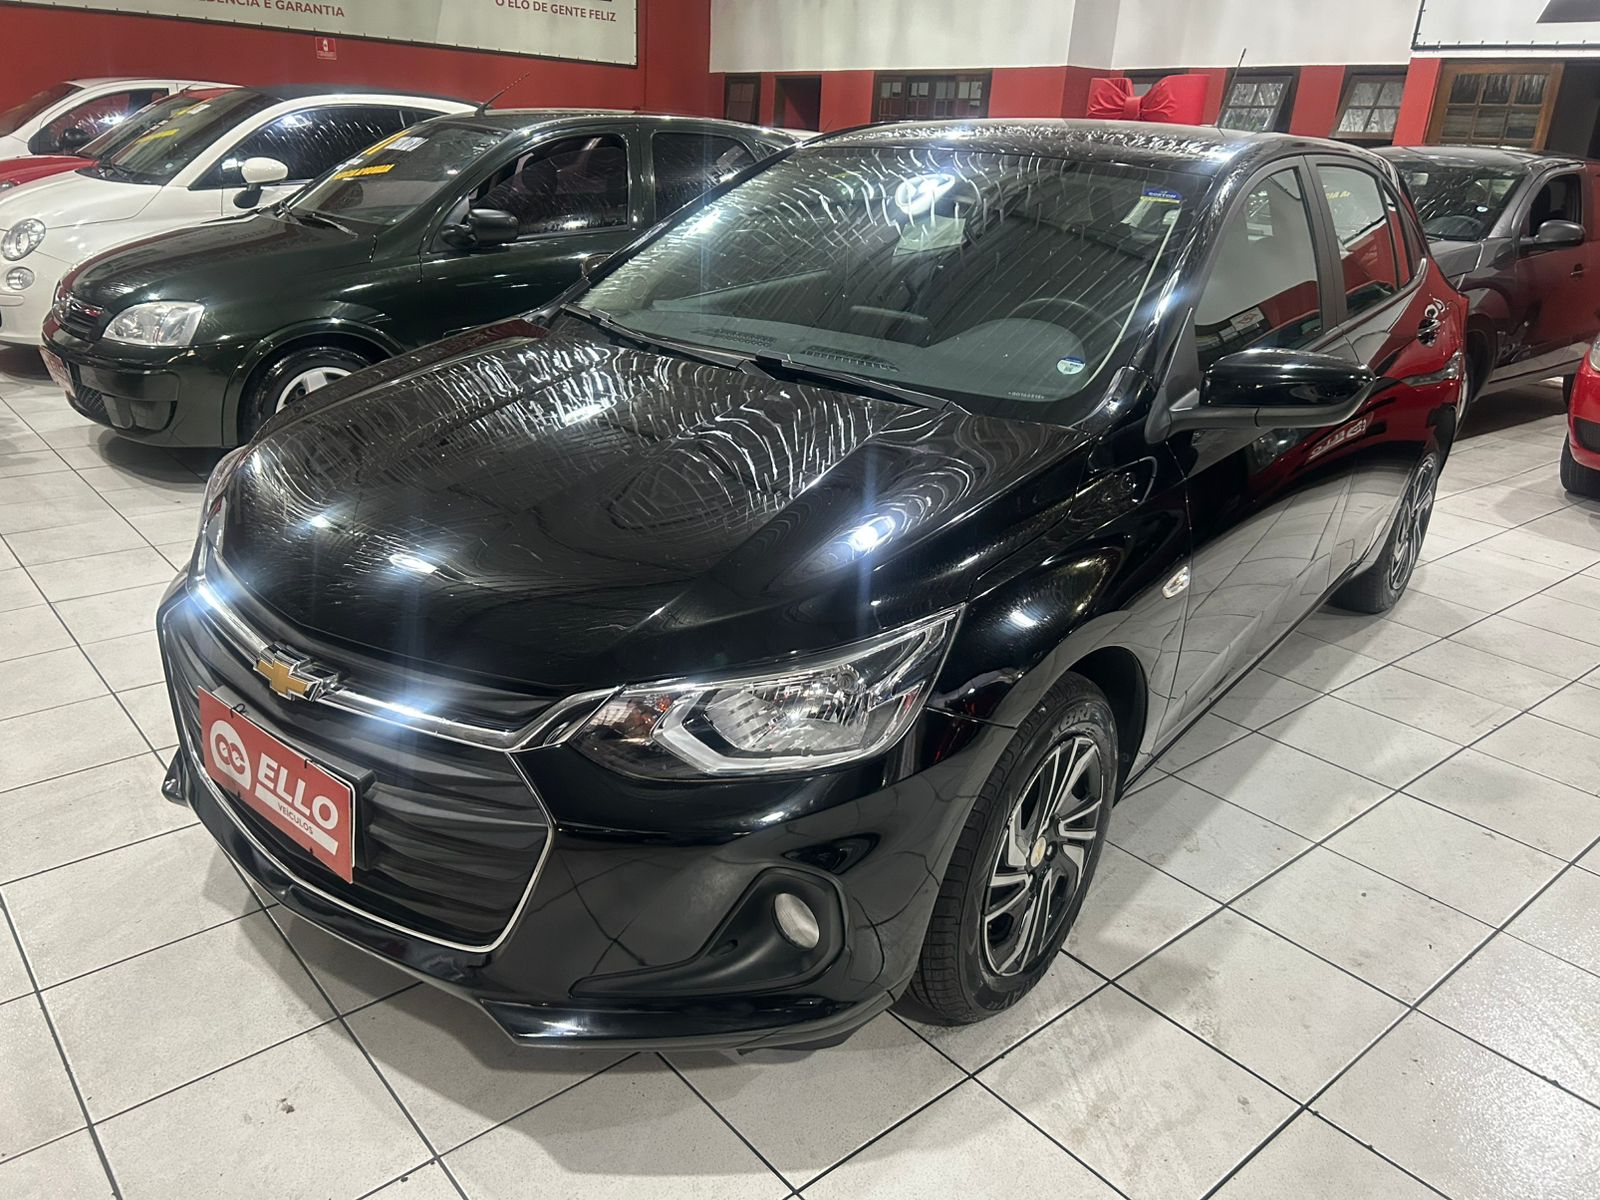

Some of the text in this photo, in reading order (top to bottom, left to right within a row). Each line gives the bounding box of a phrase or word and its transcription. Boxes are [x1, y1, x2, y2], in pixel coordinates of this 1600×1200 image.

[264, 0, 272, 8] E
[275, 0, 345, 17] GARANTIA
[508, 0, 530, 10] ELO
[533, 1, 548, 13] DE
[550, 4, 586, 18] GENTE
[589, 9, 616, 21] FELIZ
[257, 752, 338, 830] ELLO
